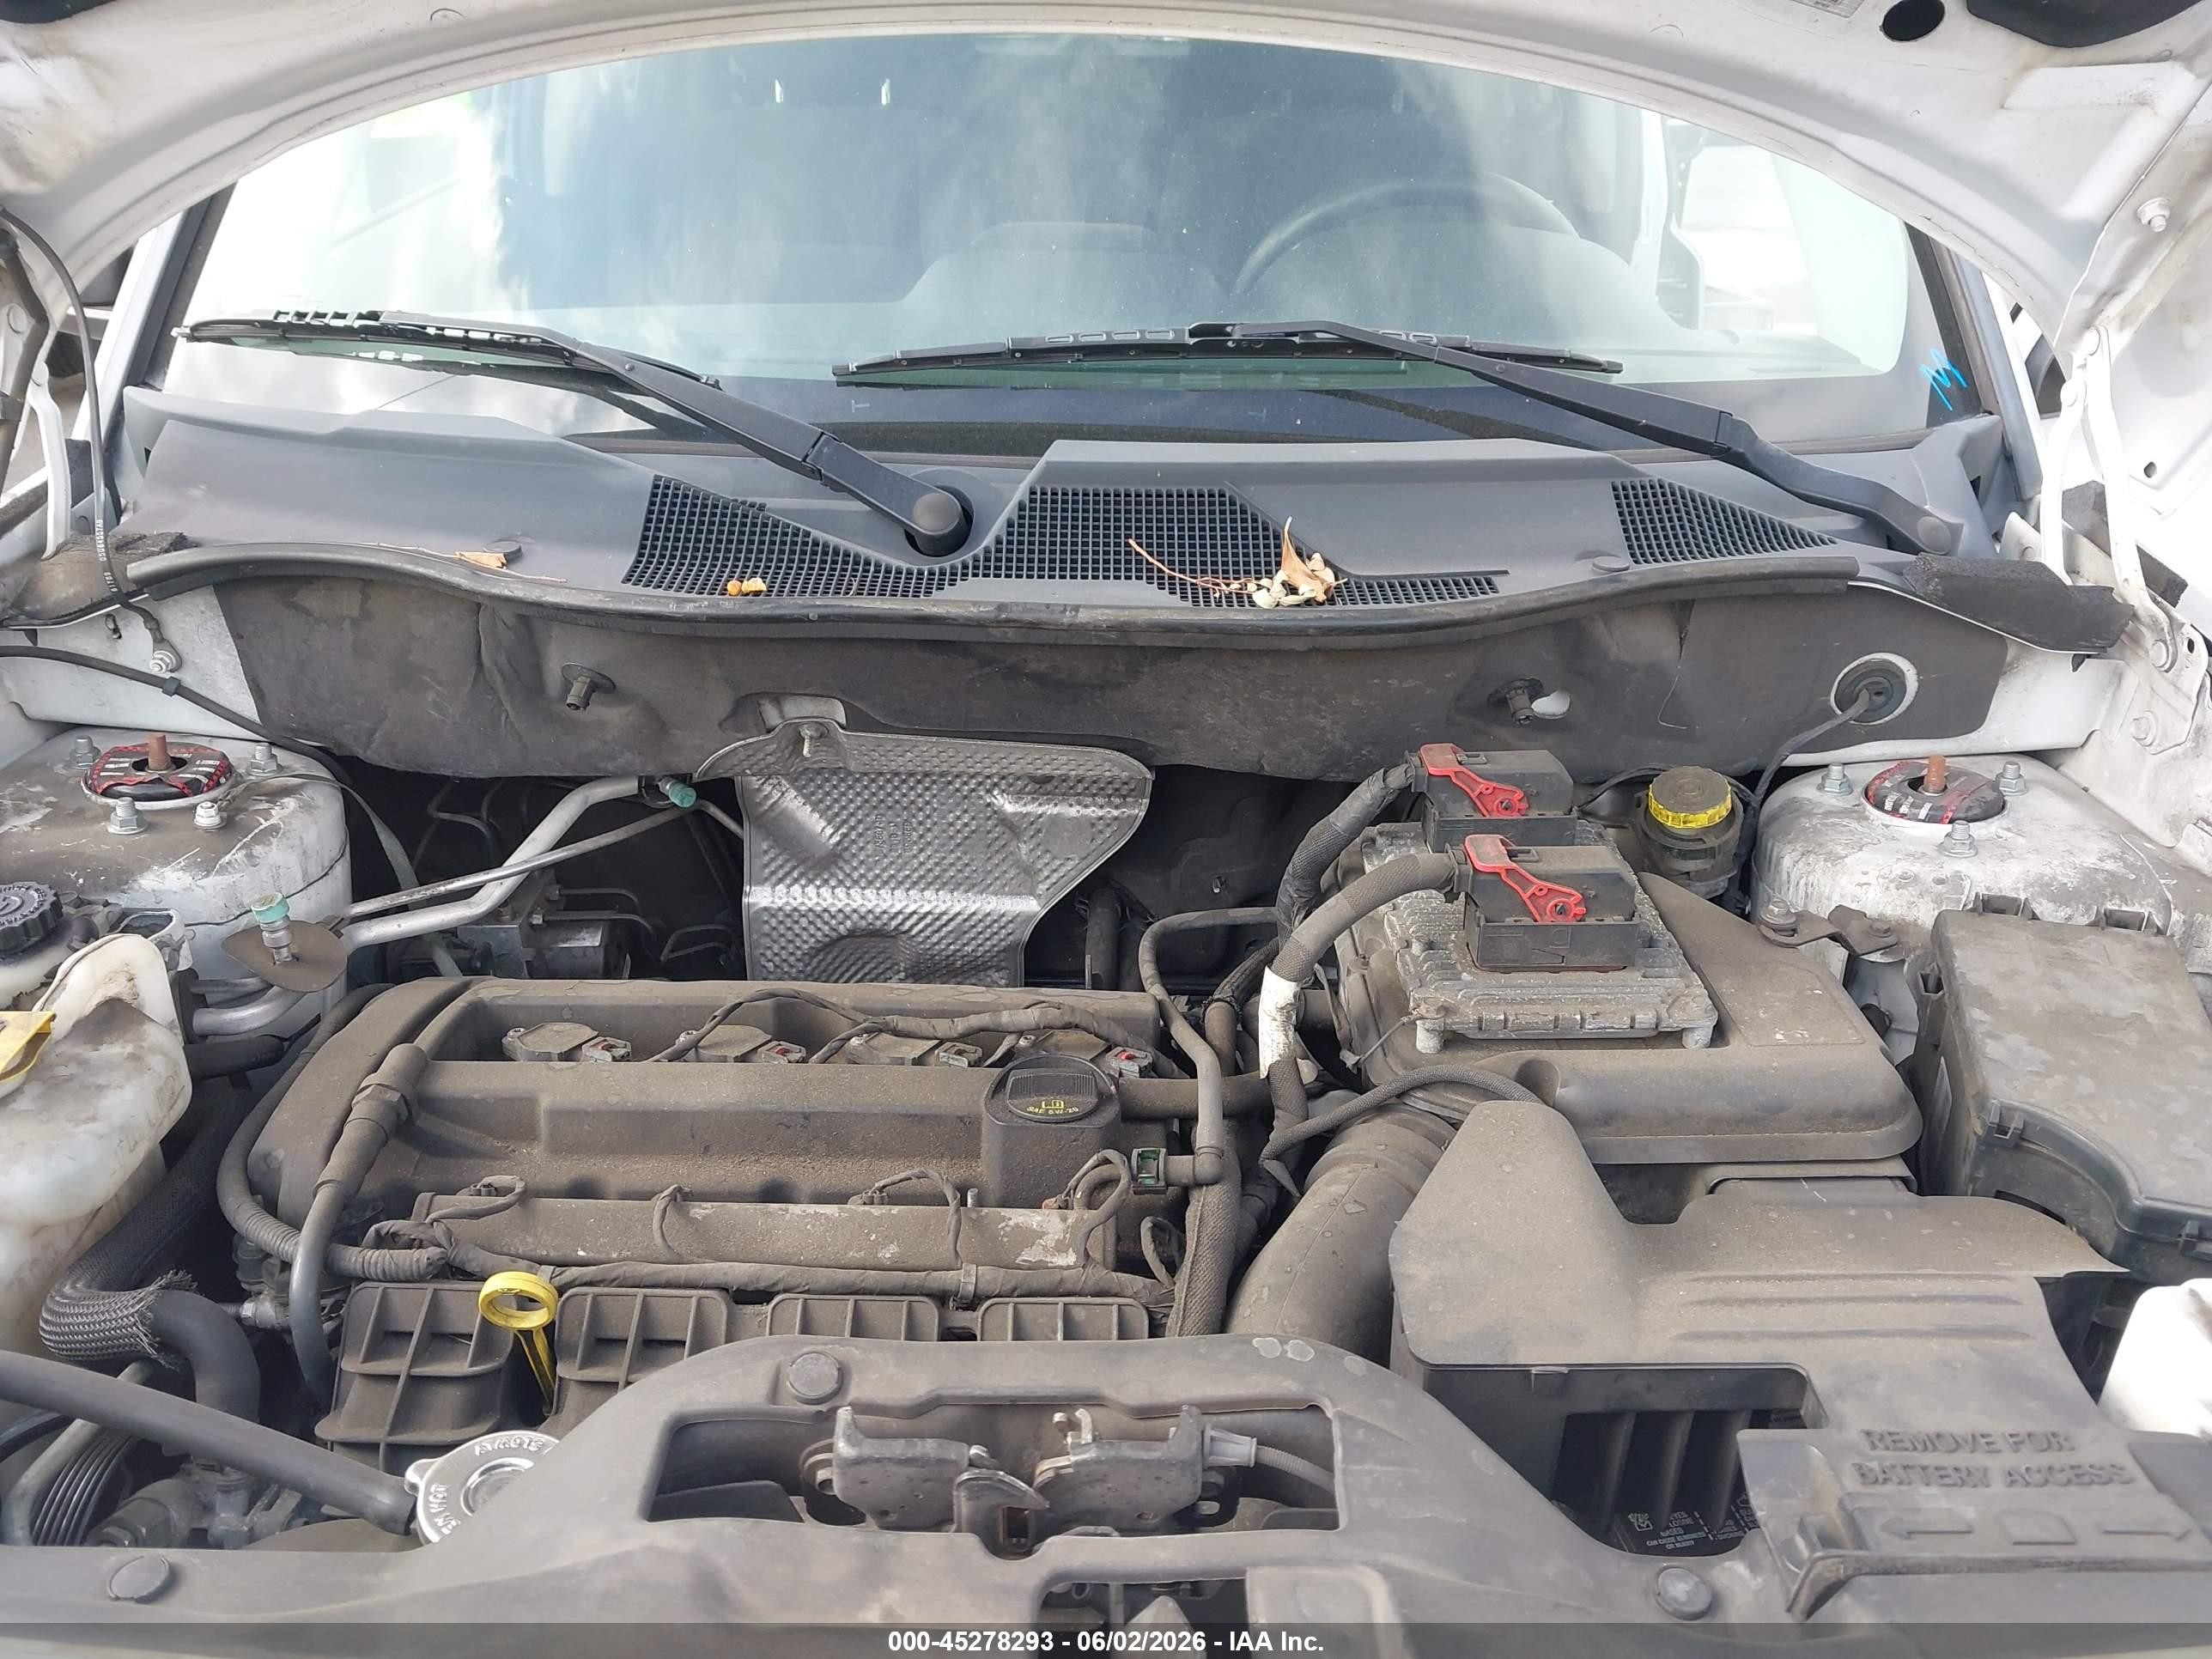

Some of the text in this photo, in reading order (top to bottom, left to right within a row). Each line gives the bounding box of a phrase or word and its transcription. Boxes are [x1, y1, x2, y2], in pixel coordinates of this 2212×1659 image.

[1026, 1106, 1079, 1115] SAE 5W-20
[1860, 1428, 2075, 1454] REMOVE FOR
[1851, 1462, 2136, 1488] BATTERY ACCESS
[428, 1483, 448, 1513] HOT
